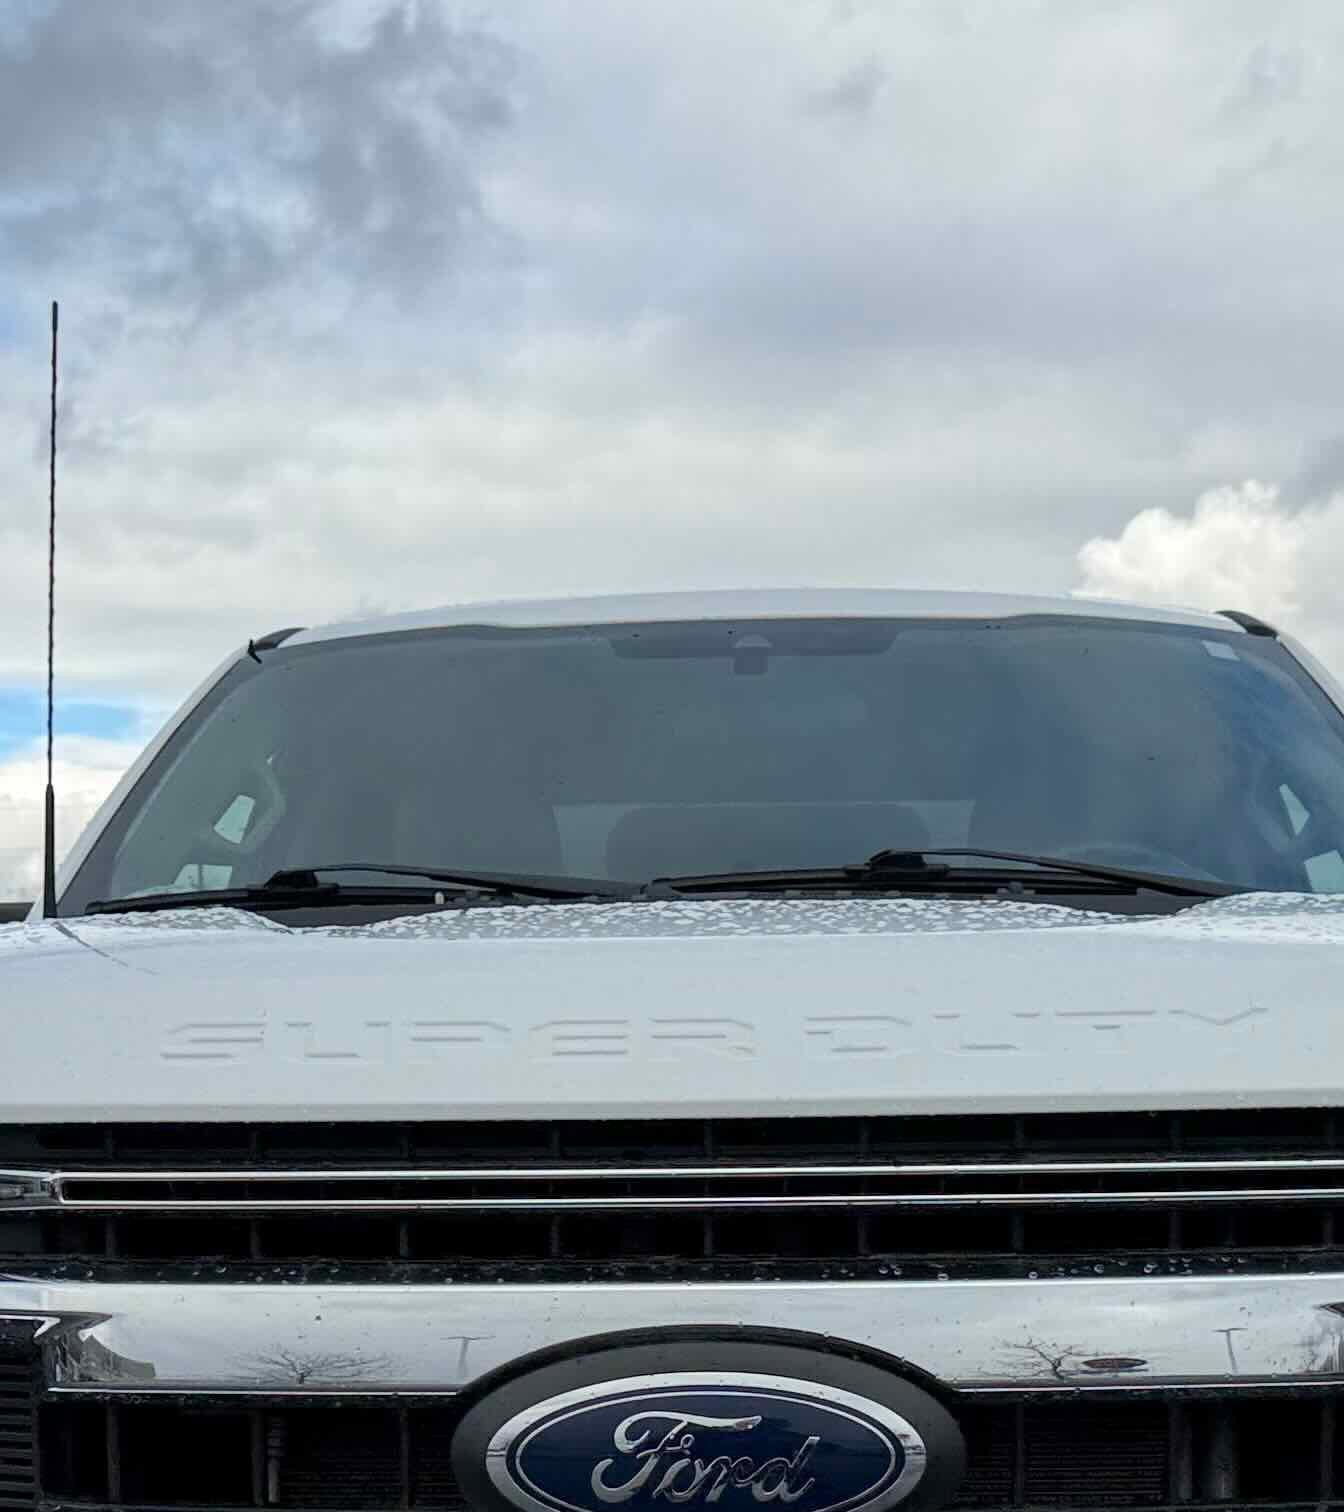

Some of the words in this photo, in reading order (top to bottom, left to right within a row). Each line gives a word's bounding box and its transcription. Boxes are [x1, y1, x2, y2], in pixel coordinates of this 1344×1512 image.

[159, 1016, 756, 1064] SUPER
[800, 1007, 1270, 1058] DUTY
[590, 1410, 822, 1502] Ford
